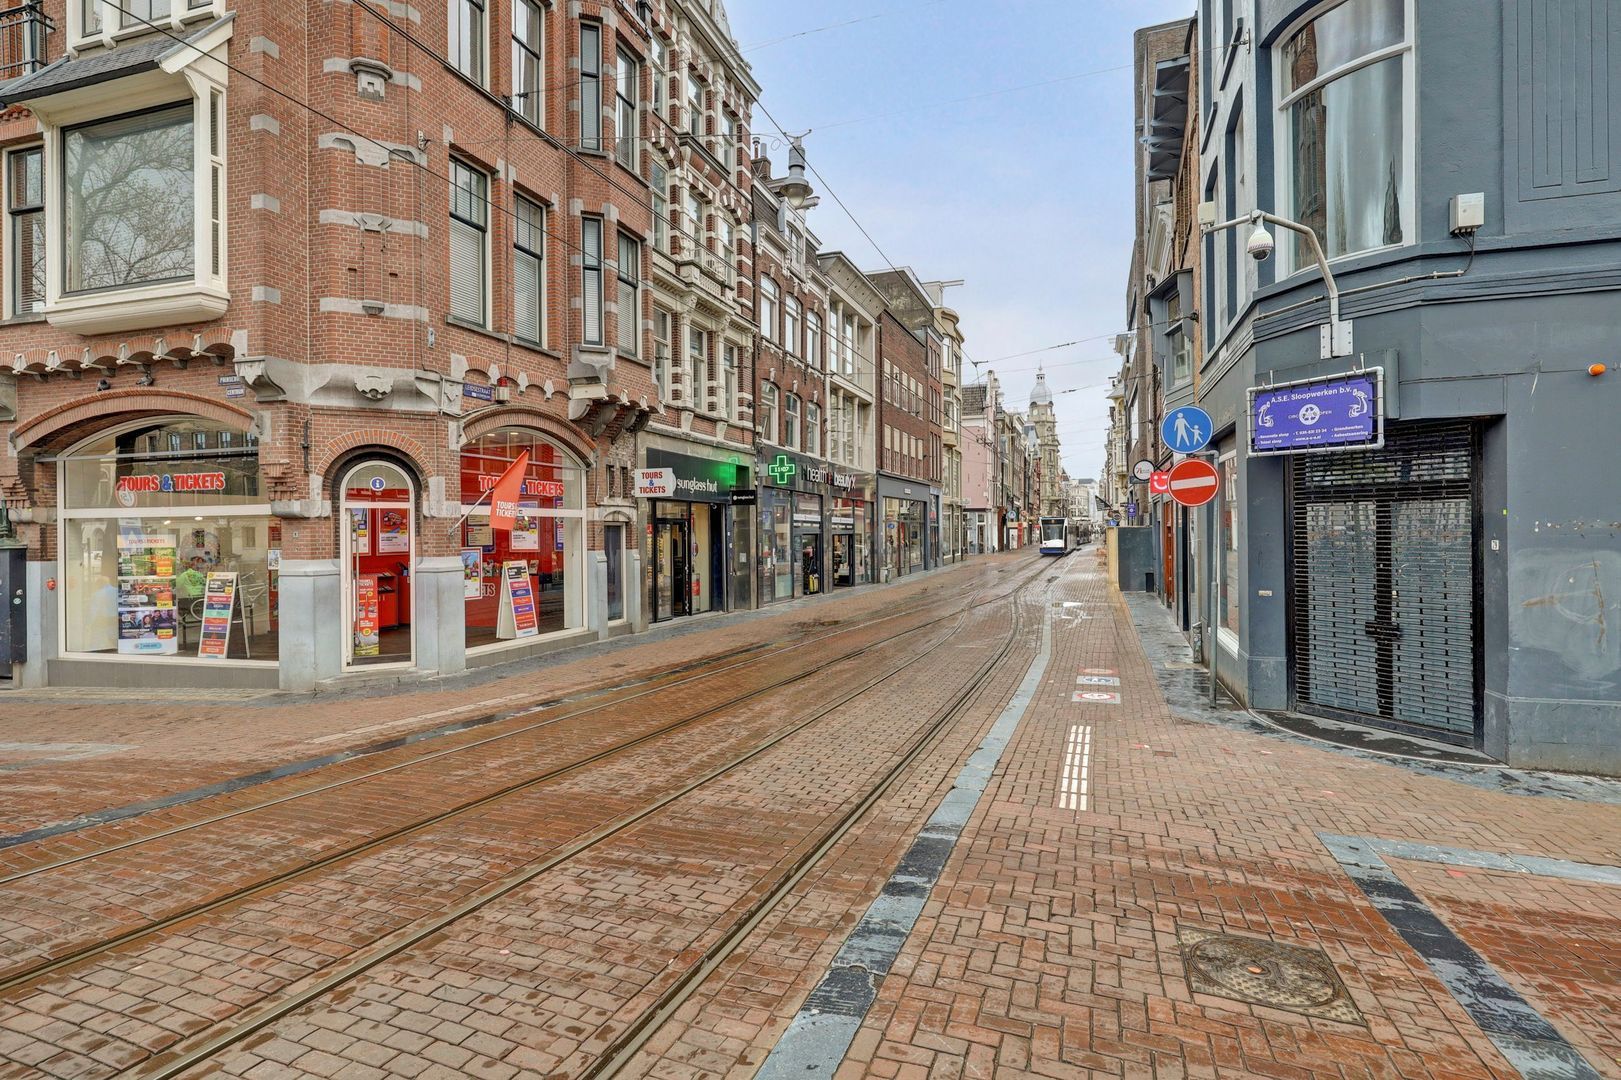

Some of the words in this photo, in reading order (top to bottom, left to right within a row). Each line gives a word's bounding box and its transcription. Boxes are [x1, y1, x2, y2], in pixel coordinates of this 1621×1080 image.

[465, 384, 491, 395] LEIDSESTRAAT
[1291, 388, 1338, 401] Sloopwerken
[1340, 386, 1352, 394] b.v.
[119, 475, 160, 491] TOURS
[161, 474, 173, 491] &
[173, 472, 226, 491] TICKETS
[641, 471, 663, 479] TOURS
[807, 465, 828, 483] health
[526, 480, 564, 497] TICKETS
[639, 486, 666, 494] TICKETS
[676, 477, 707, 493] sunglass
[707, 479, 718, 492] hut
[497, 501, 516, 510] TOURS
